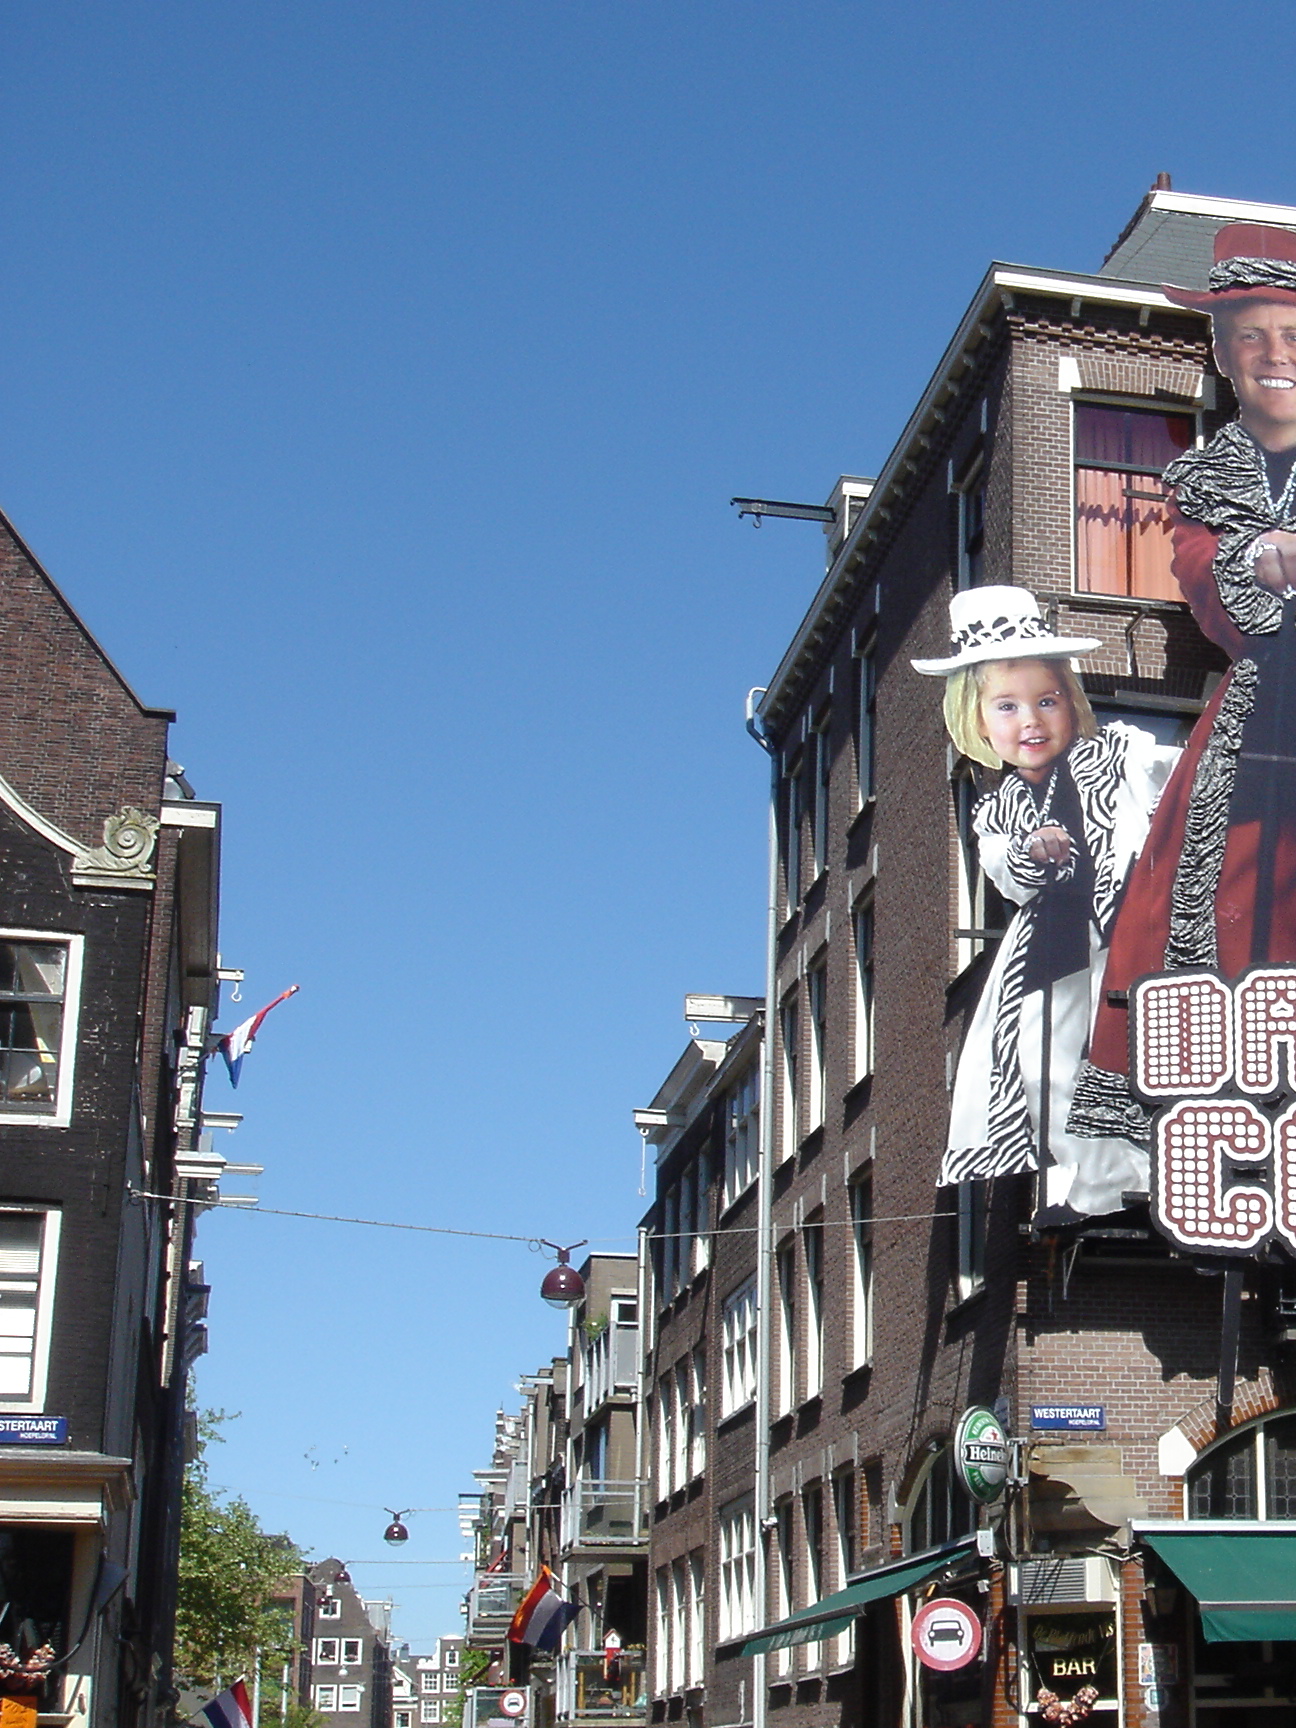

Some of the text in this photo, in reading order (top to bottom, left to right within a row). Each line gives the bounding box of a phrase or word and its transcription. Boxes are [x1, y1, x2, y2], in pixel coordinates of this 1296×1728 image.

[1033, 1407, 1101, 1419] WESTERTAART
[0, 1420, 59, 1431] STERTAART
[969, 1446, 1006, 1461] Heine
[1053, 1656, 1097, 1676] BAR
